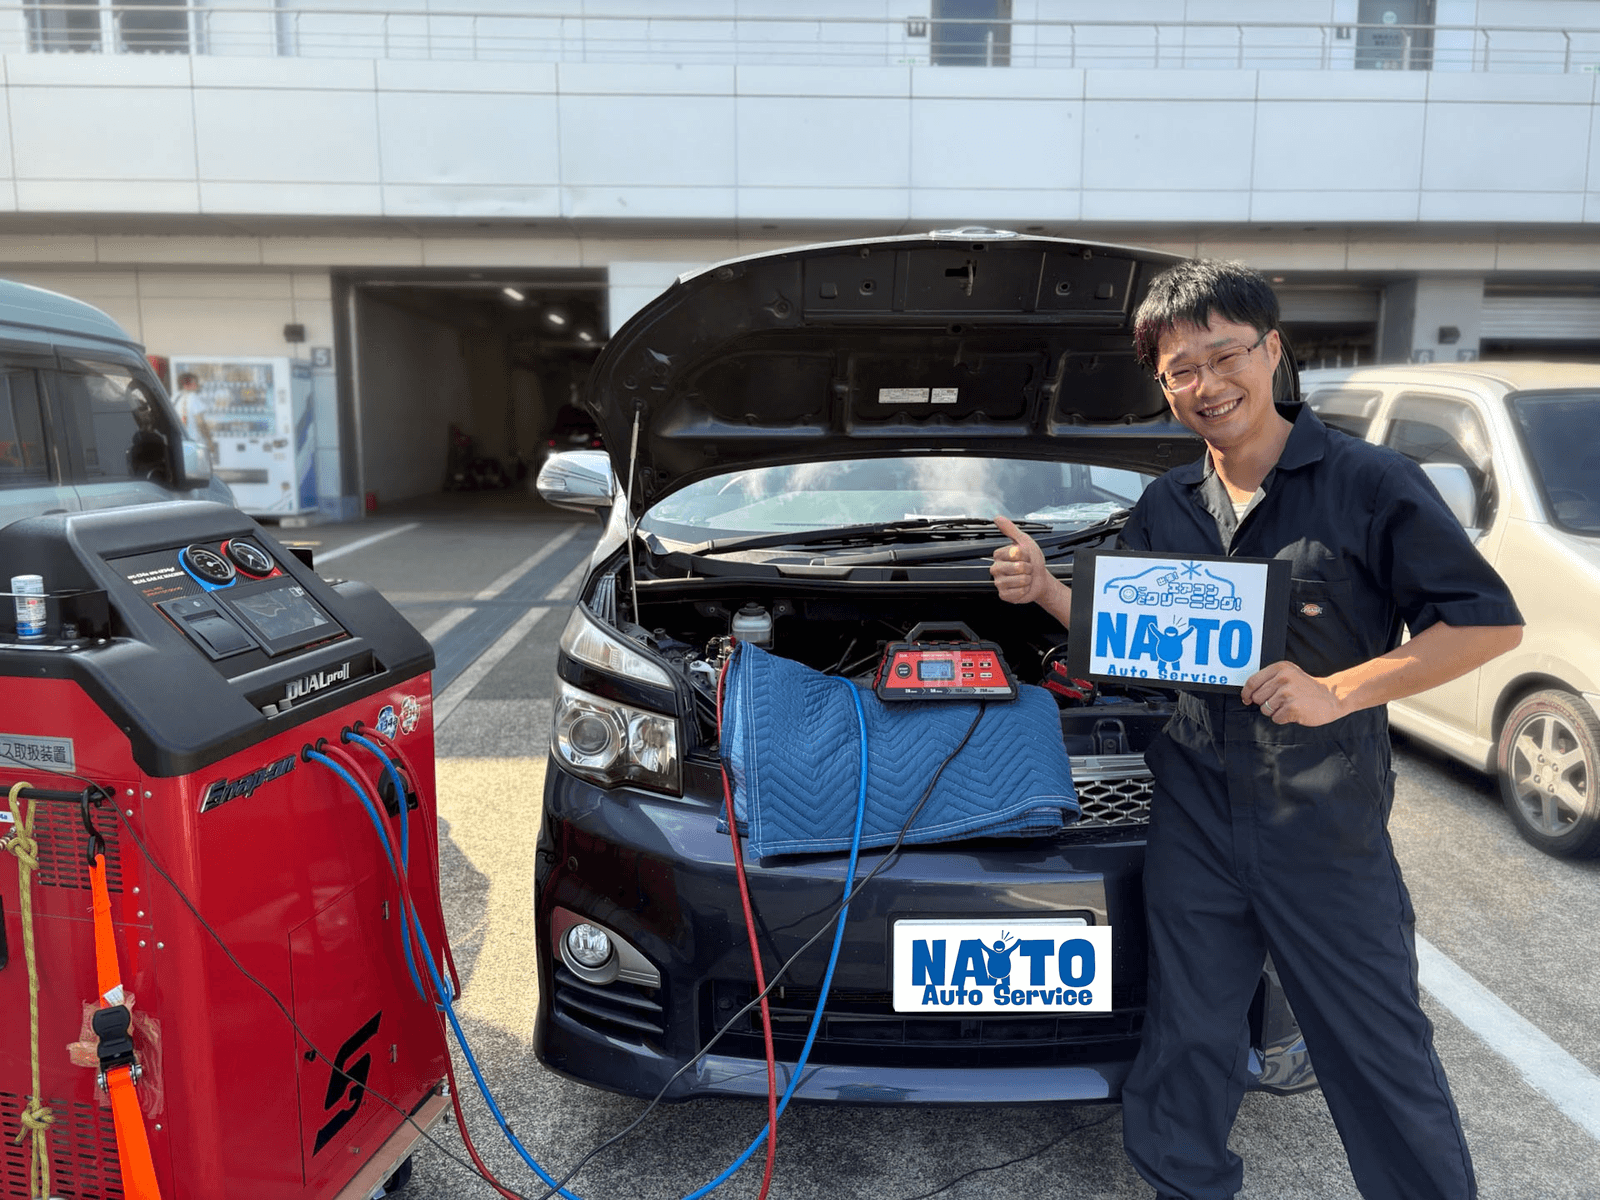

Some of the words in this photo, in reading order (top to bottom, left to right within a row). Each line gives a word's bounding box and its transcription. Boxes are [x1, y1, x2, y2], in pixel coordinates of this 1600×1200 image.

[1168, 582, 1219, 596] エアコン
[1107, 664, 1148, 679] Auto
[1158, 669, 1228, 685] Service
[0, 742, 67, 764] ス取扱装置
